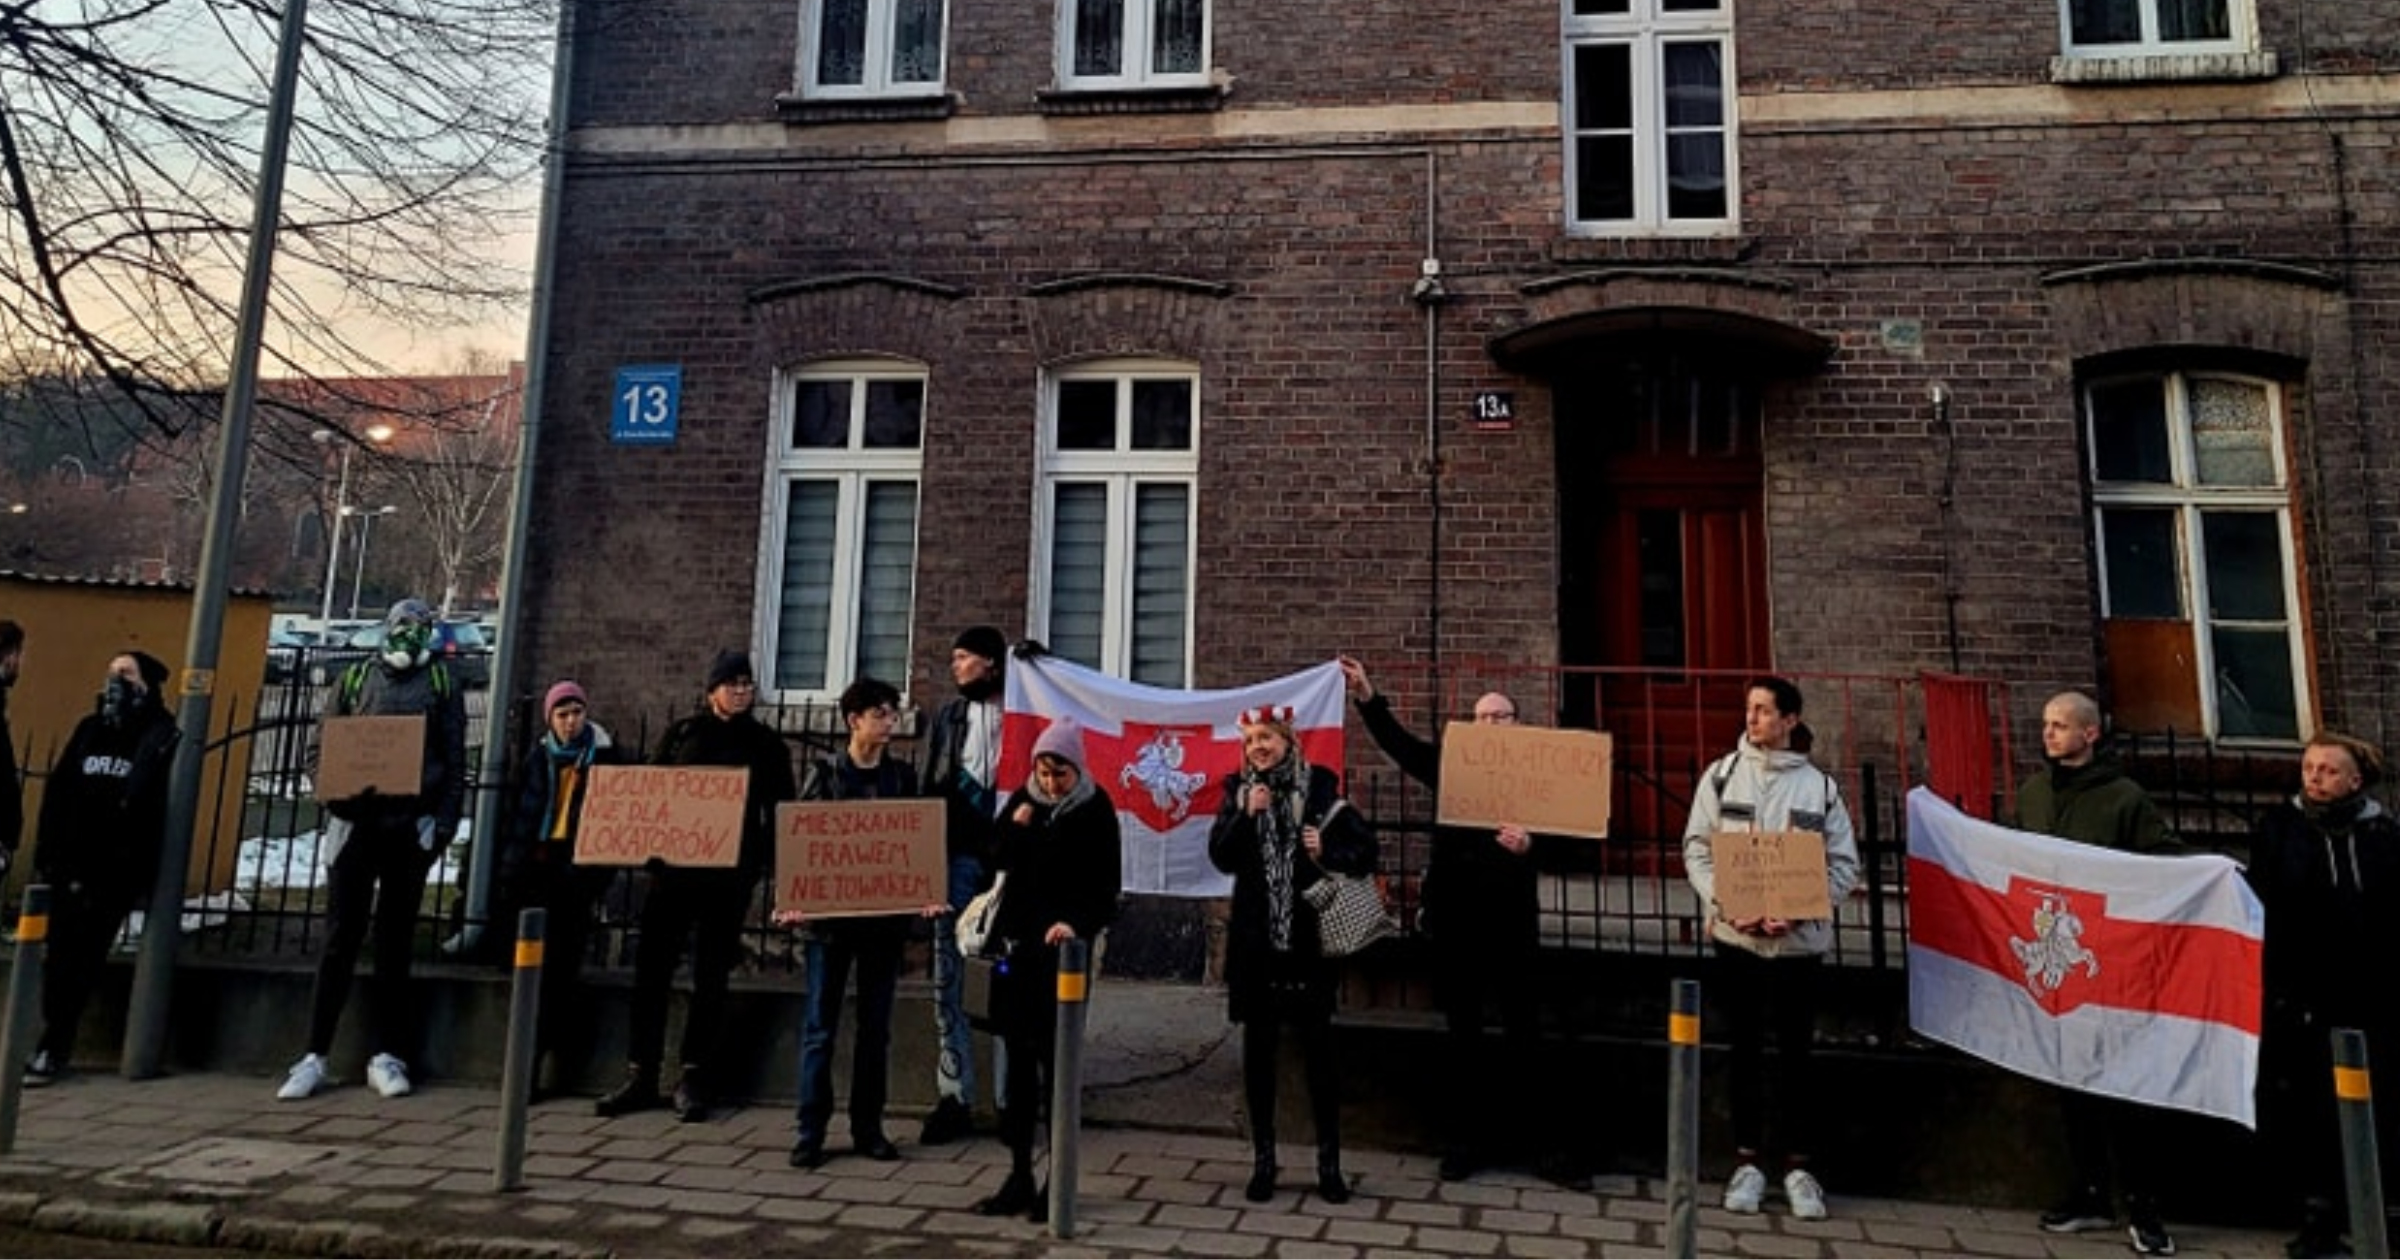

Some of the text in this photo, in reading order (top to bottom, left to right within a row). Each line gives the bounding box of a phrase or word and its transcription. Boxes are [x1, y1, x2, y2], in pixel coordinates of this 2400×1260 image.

[623, 385, 669, 424] 13
[628, 799, 670, 824] DLA
[579, 817, 730, 859] LOKATORÓW
[789, 874, 829, 901] NIE
